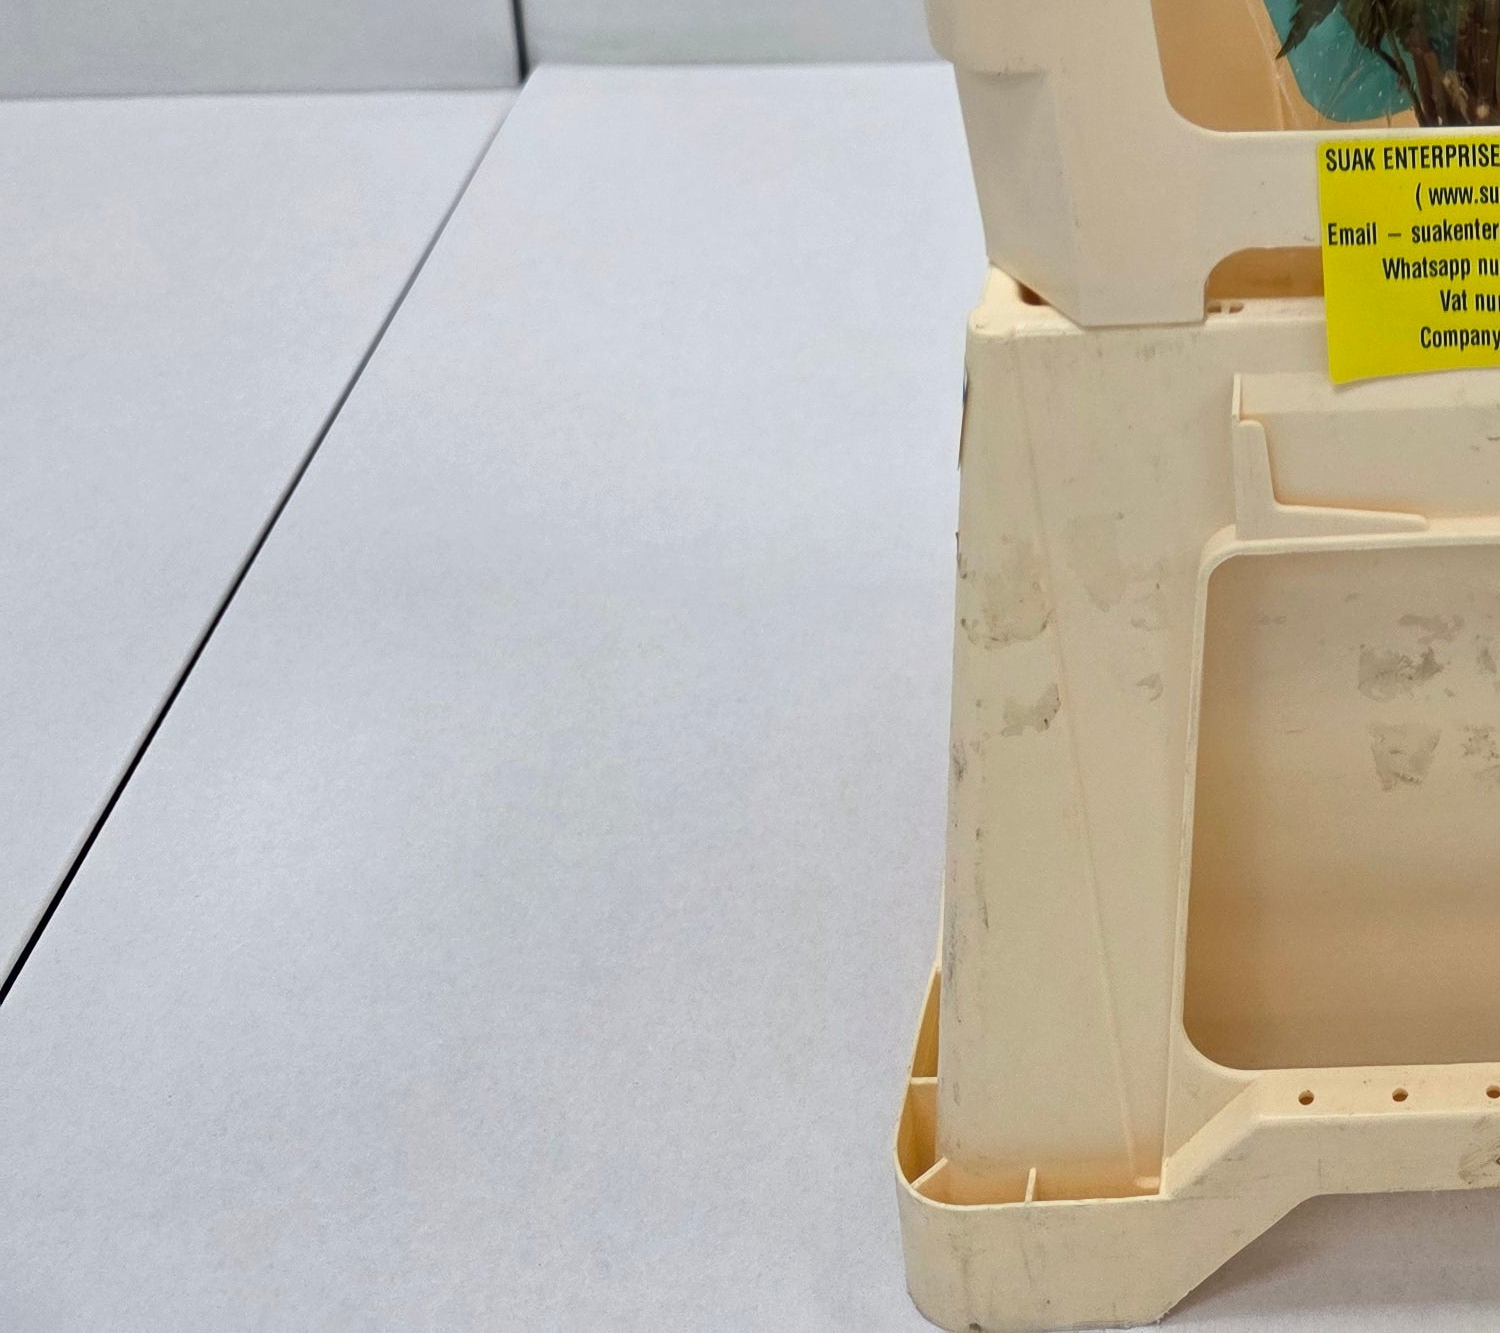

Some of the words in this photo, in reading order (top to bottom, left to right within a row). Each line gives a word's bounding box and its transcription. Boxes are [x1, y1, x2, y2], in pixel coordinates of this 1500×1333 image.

[1326, 148, 1375, 172] SUAK
[1328, 222, 1377, 246] Email
[1382, 257, 1470, 280] Whatsapp
[1440, 290, 1467, 312] Vat
[1421, 326, 1500, 351] Company
